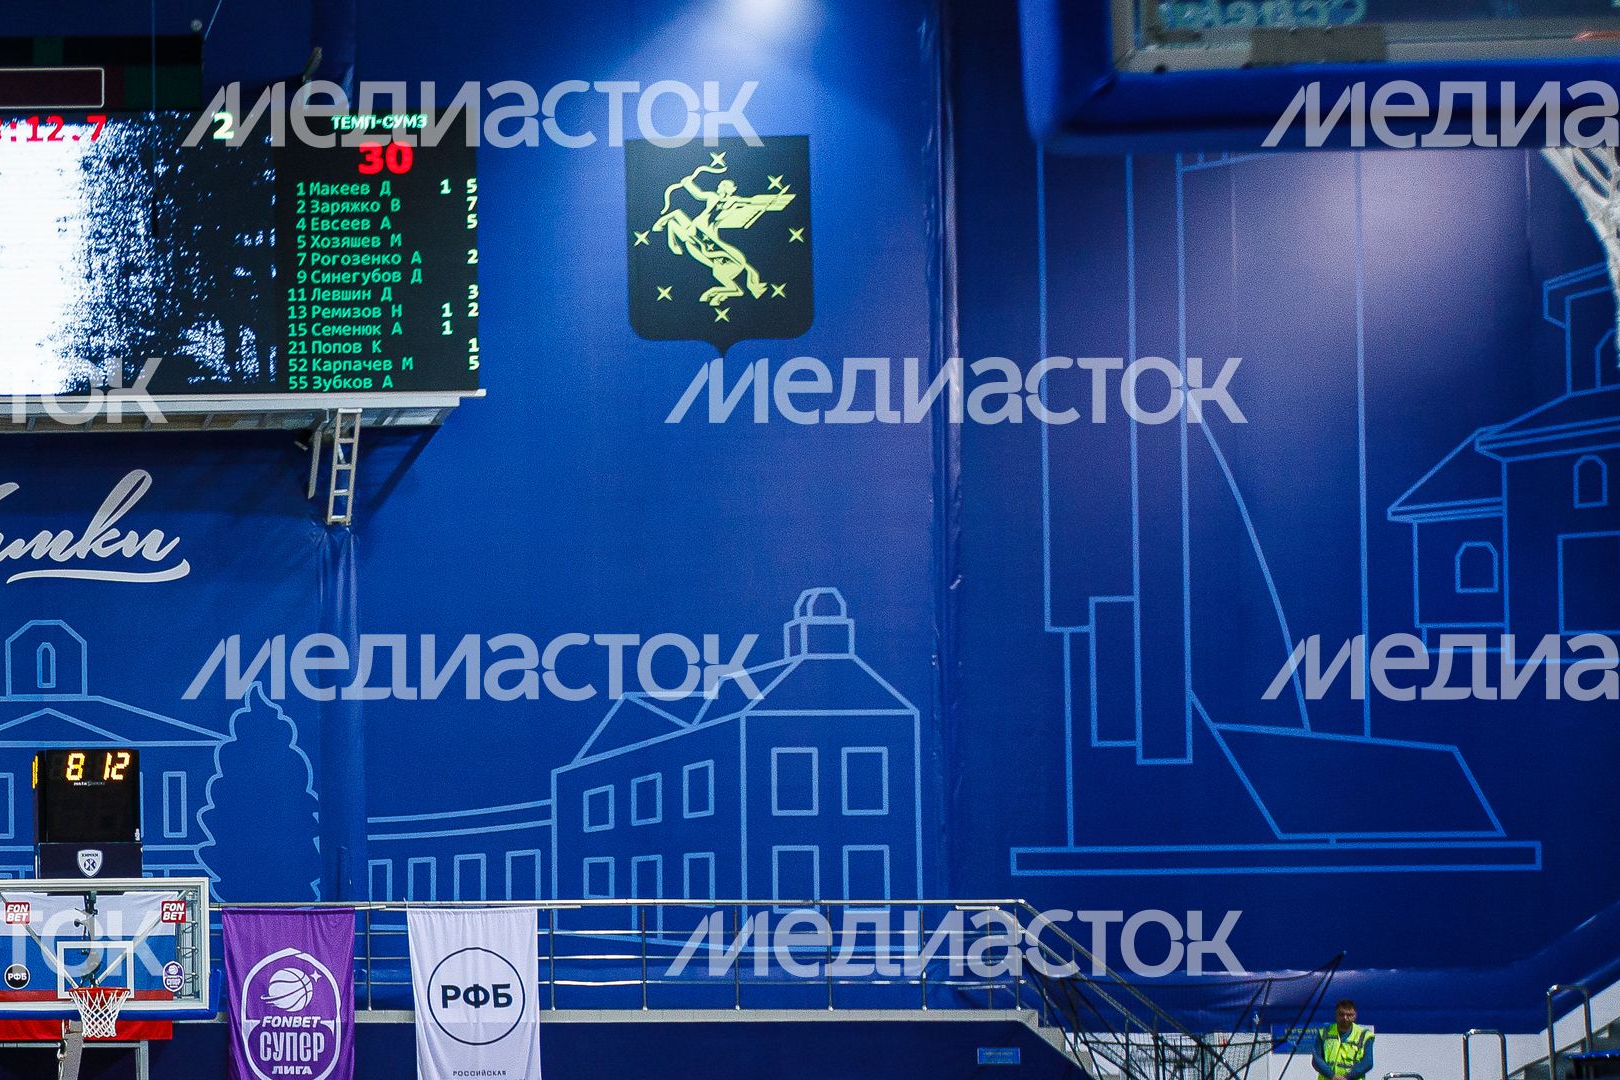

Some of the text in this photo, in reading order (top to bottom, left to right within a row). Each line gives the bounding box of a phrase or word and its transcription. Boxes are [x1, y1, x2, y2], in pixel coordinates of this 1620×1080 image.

[213, 112, 234, 140] 2
[331, 114, 428, 130] ТЕМП-СУМЗ
[358, 141, 413, 174] 30
[296, 179, 477, 197] 1 Макеев Д 1 5
[296, 196, 477, 215] 2 Заряжко В 7
[296, 214, 477, 231] 4 Евсеев А 5
[297, 233, 402, 249] 5 Хозяшев М
[297, 249, 478, 266] 7 Рогозенко А 2
[297, 268, 422, 285] 9 Синегубов Д
[287, 285, 478, 302] 11 Левшин Д 3
[287, 302, 478, 319] 13 Ремизов Н 1 2
[288, 320, 453, 337] 15 Семенюк А 1
[288, 338, 479, 355] 21 Попов К 1
[288, 355, 479, 373] 52 Карпачев М 5
[288, 374, 394, 391] 55 Зубков А
[66, 752, 130, 781] 8 12
[7, 904, 29, 913] FON
[162, 911, 184, 921] BET
[163, 903, 184, 912] FON
[7, 912, 29, 922] BET
[7, 972, 27, 981] РФБ
[441, 984, 513, 1008] РФБ
[262, 1015, 321, 1028] FONBET
[271, 1065, 313, 1075] ЛИГА
[452, 1069, 507, 1077] РОССИЙСКАЯ
